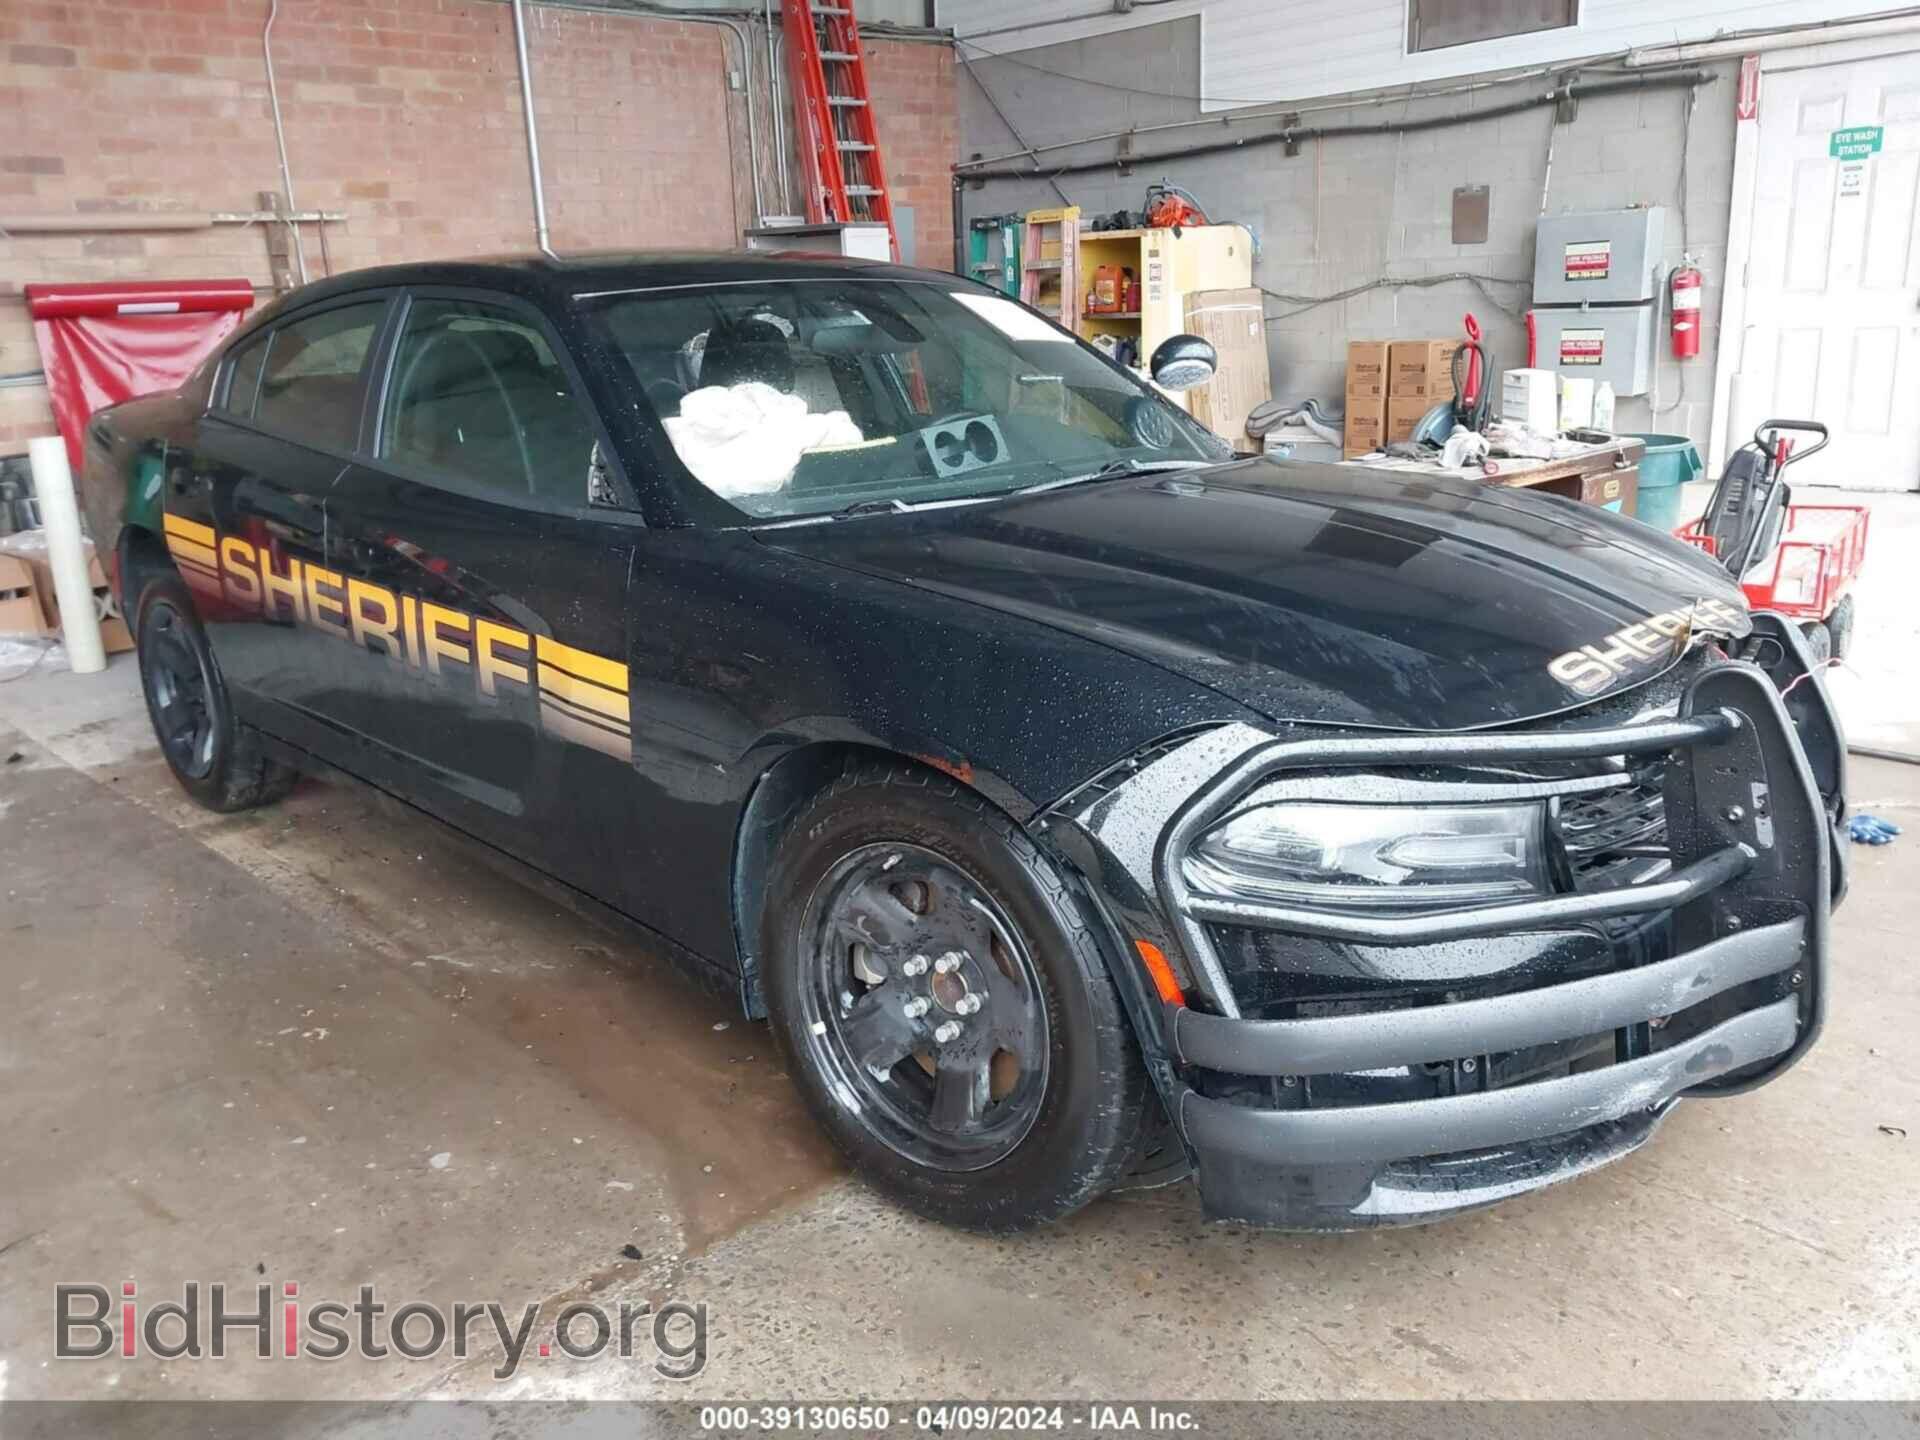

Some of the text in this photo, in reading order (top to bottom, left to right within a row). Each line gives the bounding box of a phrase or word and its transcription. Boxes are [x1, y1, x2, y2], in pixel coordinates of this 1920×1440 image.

[1834, 129, 1879, 144] EYE WASH
[1838, 142, 1873, 155] STATION
[220, 536, 529, 697] SHERIFF
